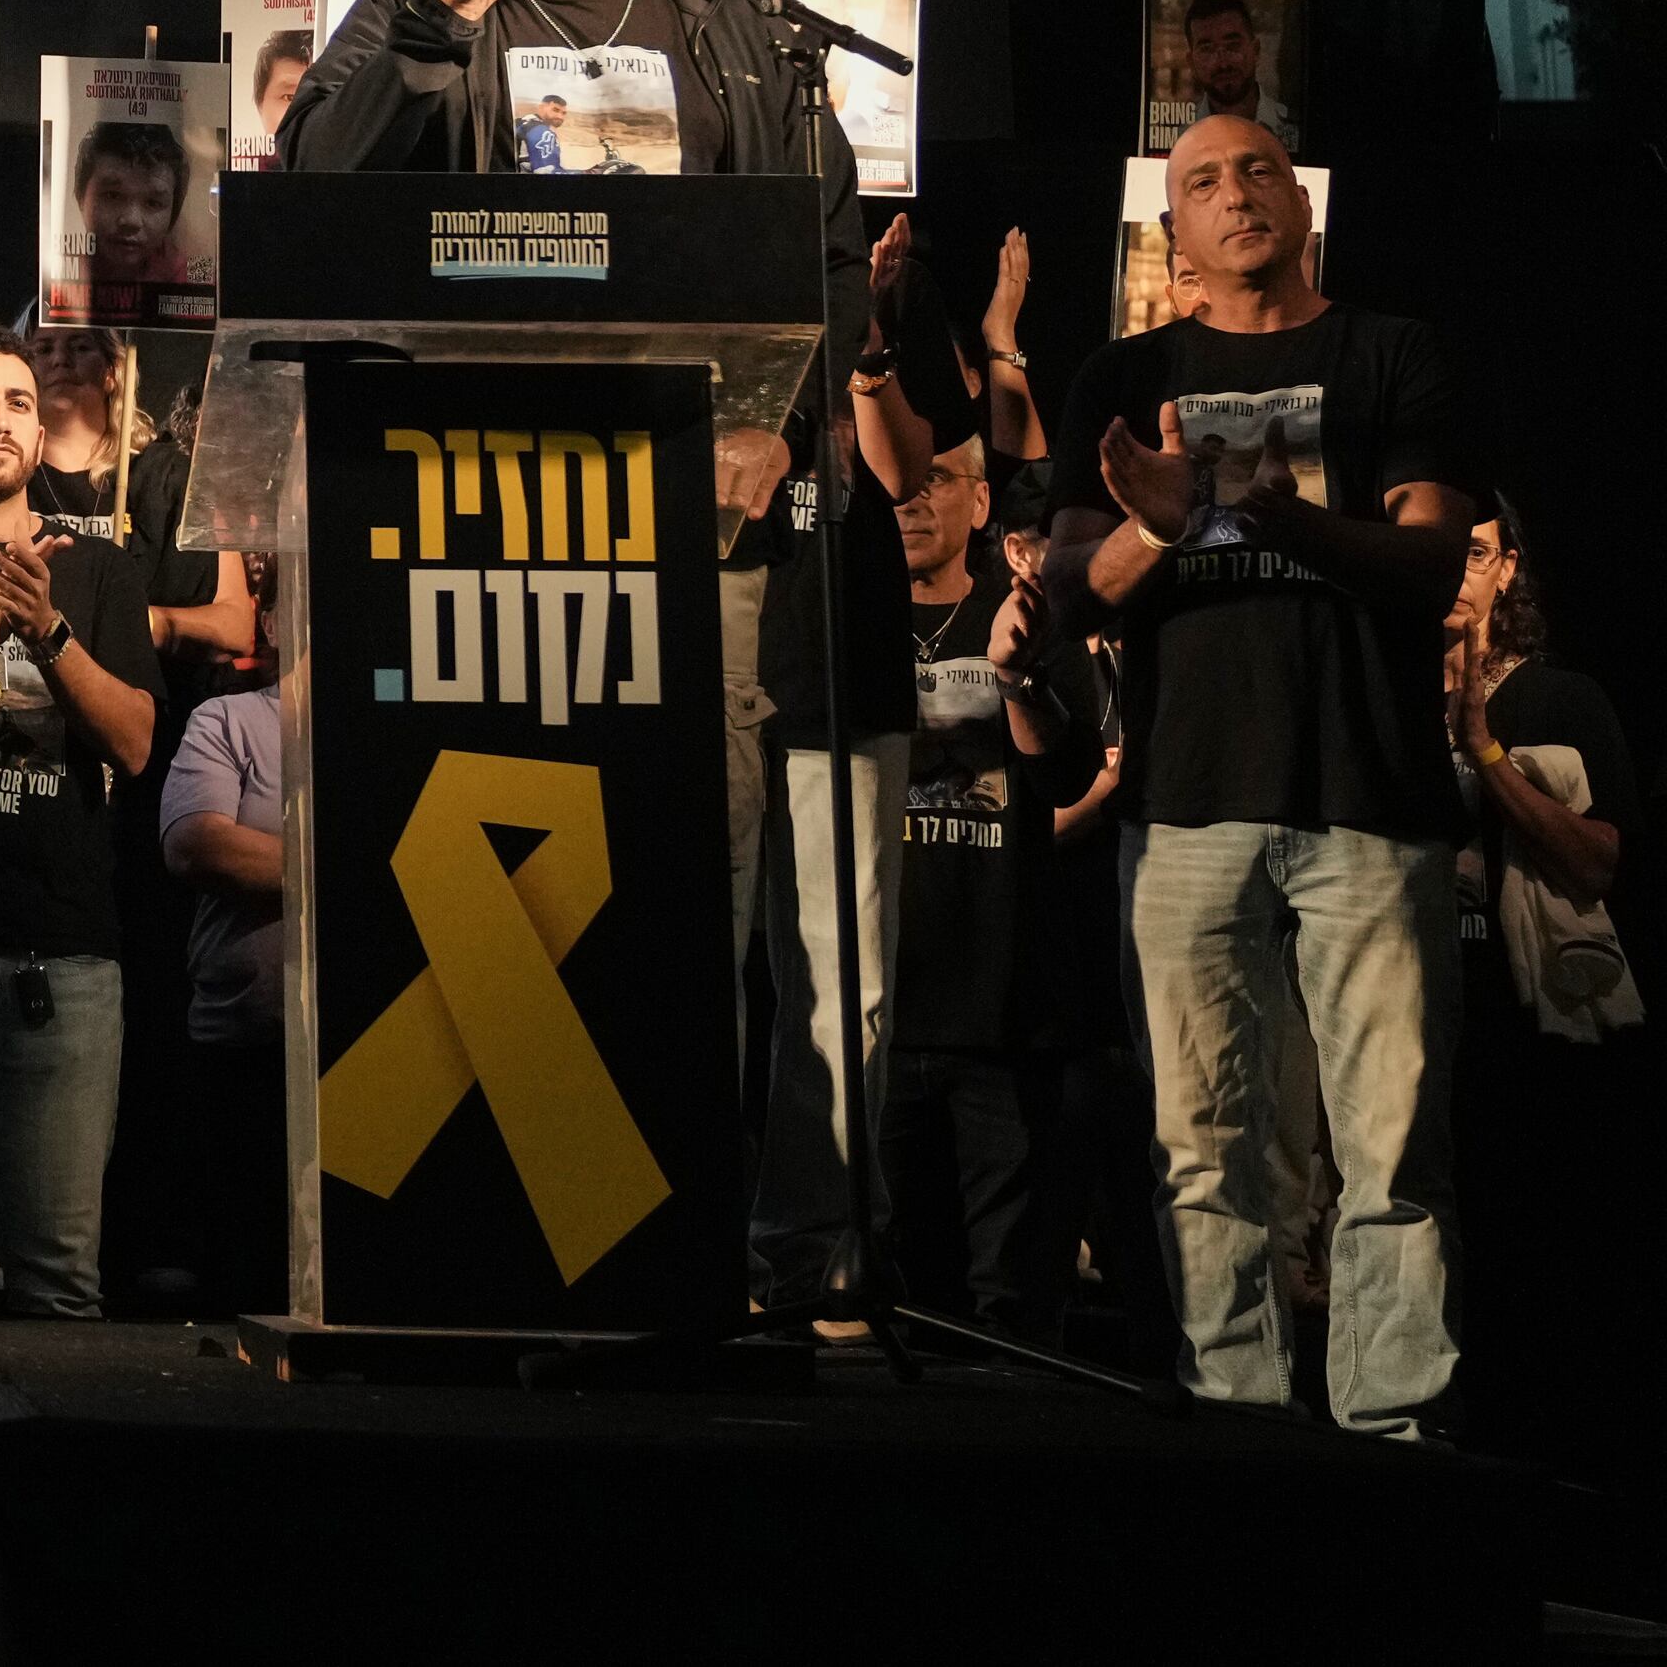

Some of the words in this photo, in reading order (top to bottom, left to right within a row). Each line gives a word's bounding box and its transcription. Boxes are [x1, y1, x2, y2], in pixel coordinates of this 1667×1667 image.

[520, 54, 568, 72] עלומים
[1151, 102, 1195, 126] BRING
[231, 132, 275, 157] BRING
[430, 209, 490, 234] להחזרת
[493, 211, 571, 235] המשפחות
[574, 212, 608, 235] מטה
[430, 237, 520, 267] והנעדרים
[524, 238, 609, 268] החטופים
[1233, 401, 1254, 418] מגן
[370, 428, 656, 561] נחזיר.
[373, 568, 662, 726] נקום.
[946, 670, 980, 684] גואילי
[28, 772, 60, 797] YOU
[917, 815, 941, 844] לך
[946, 818, 1002, 848] מחכים
